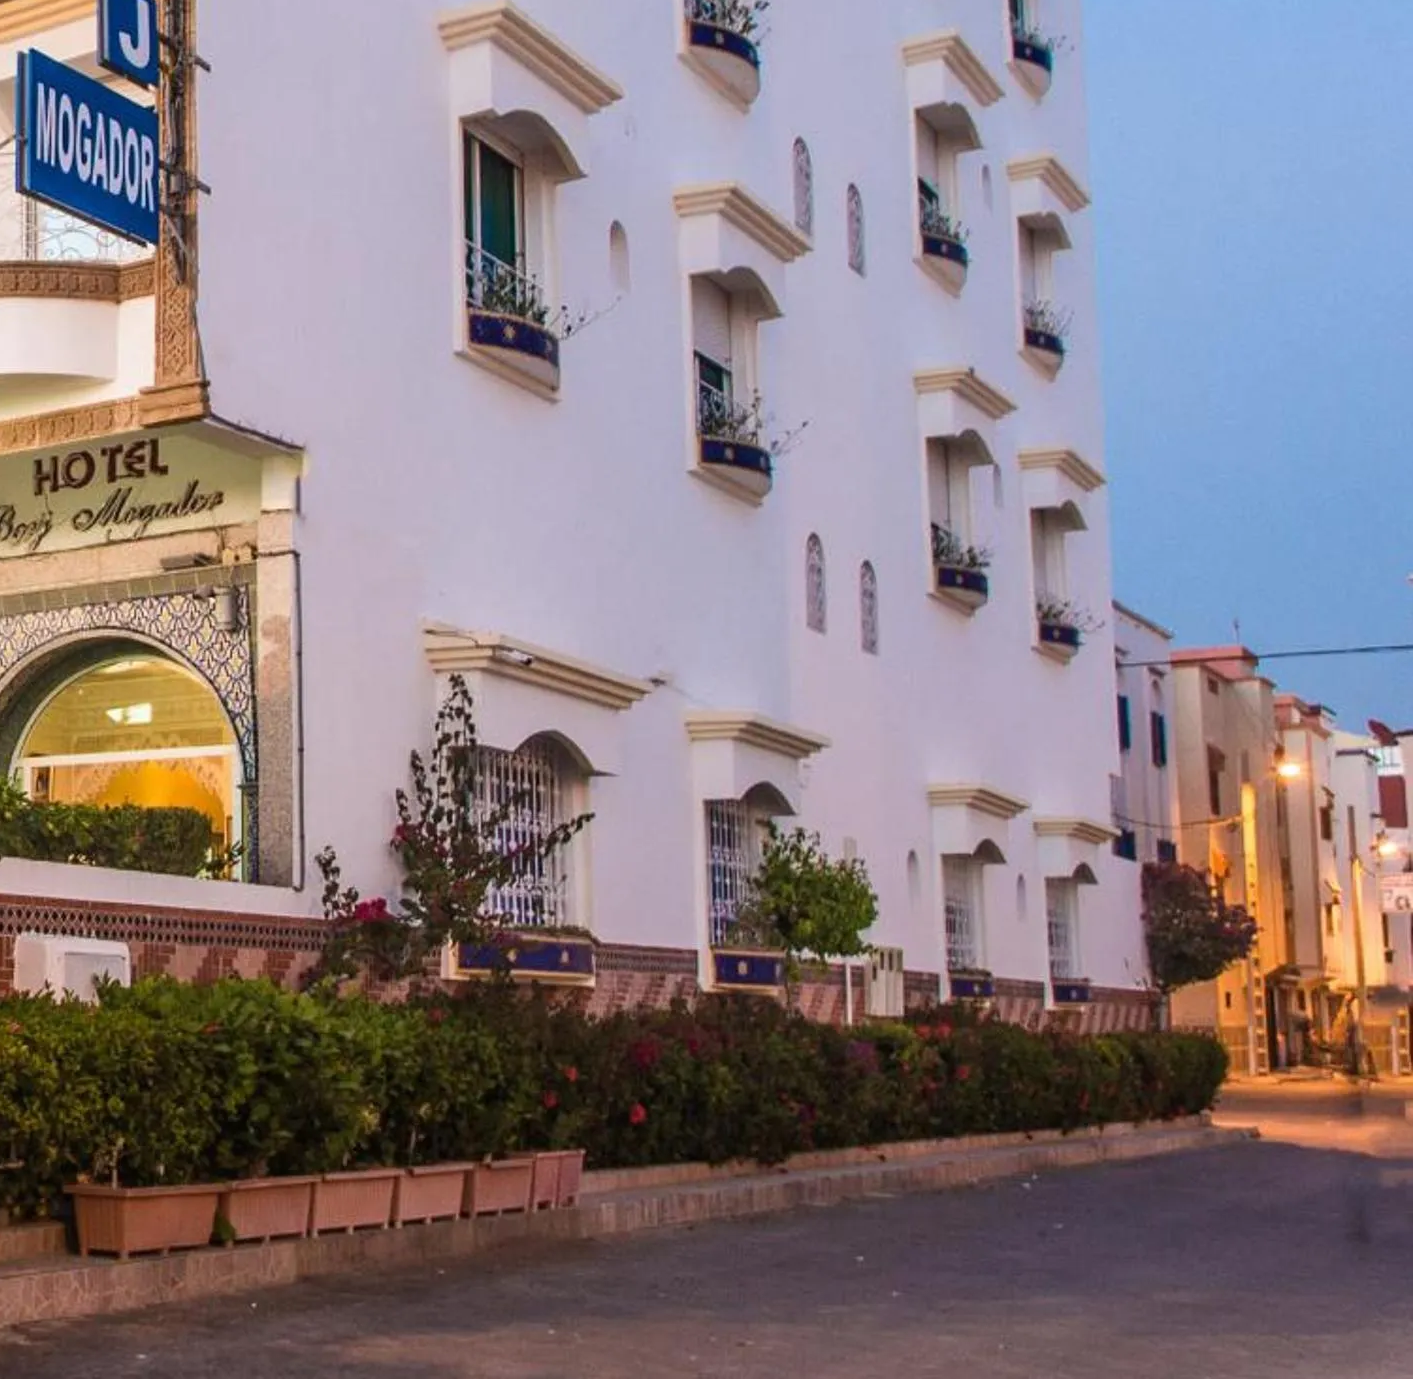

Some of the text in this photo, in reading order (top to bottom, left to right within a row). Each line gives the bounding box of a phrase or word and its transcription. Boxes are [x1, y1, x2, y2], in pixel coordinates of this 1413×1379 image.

[36, 83, 155, 213] MOGADOR
[34, 438, 168, 496] HOTEL
[72, 479, 224, 537] Mogador
